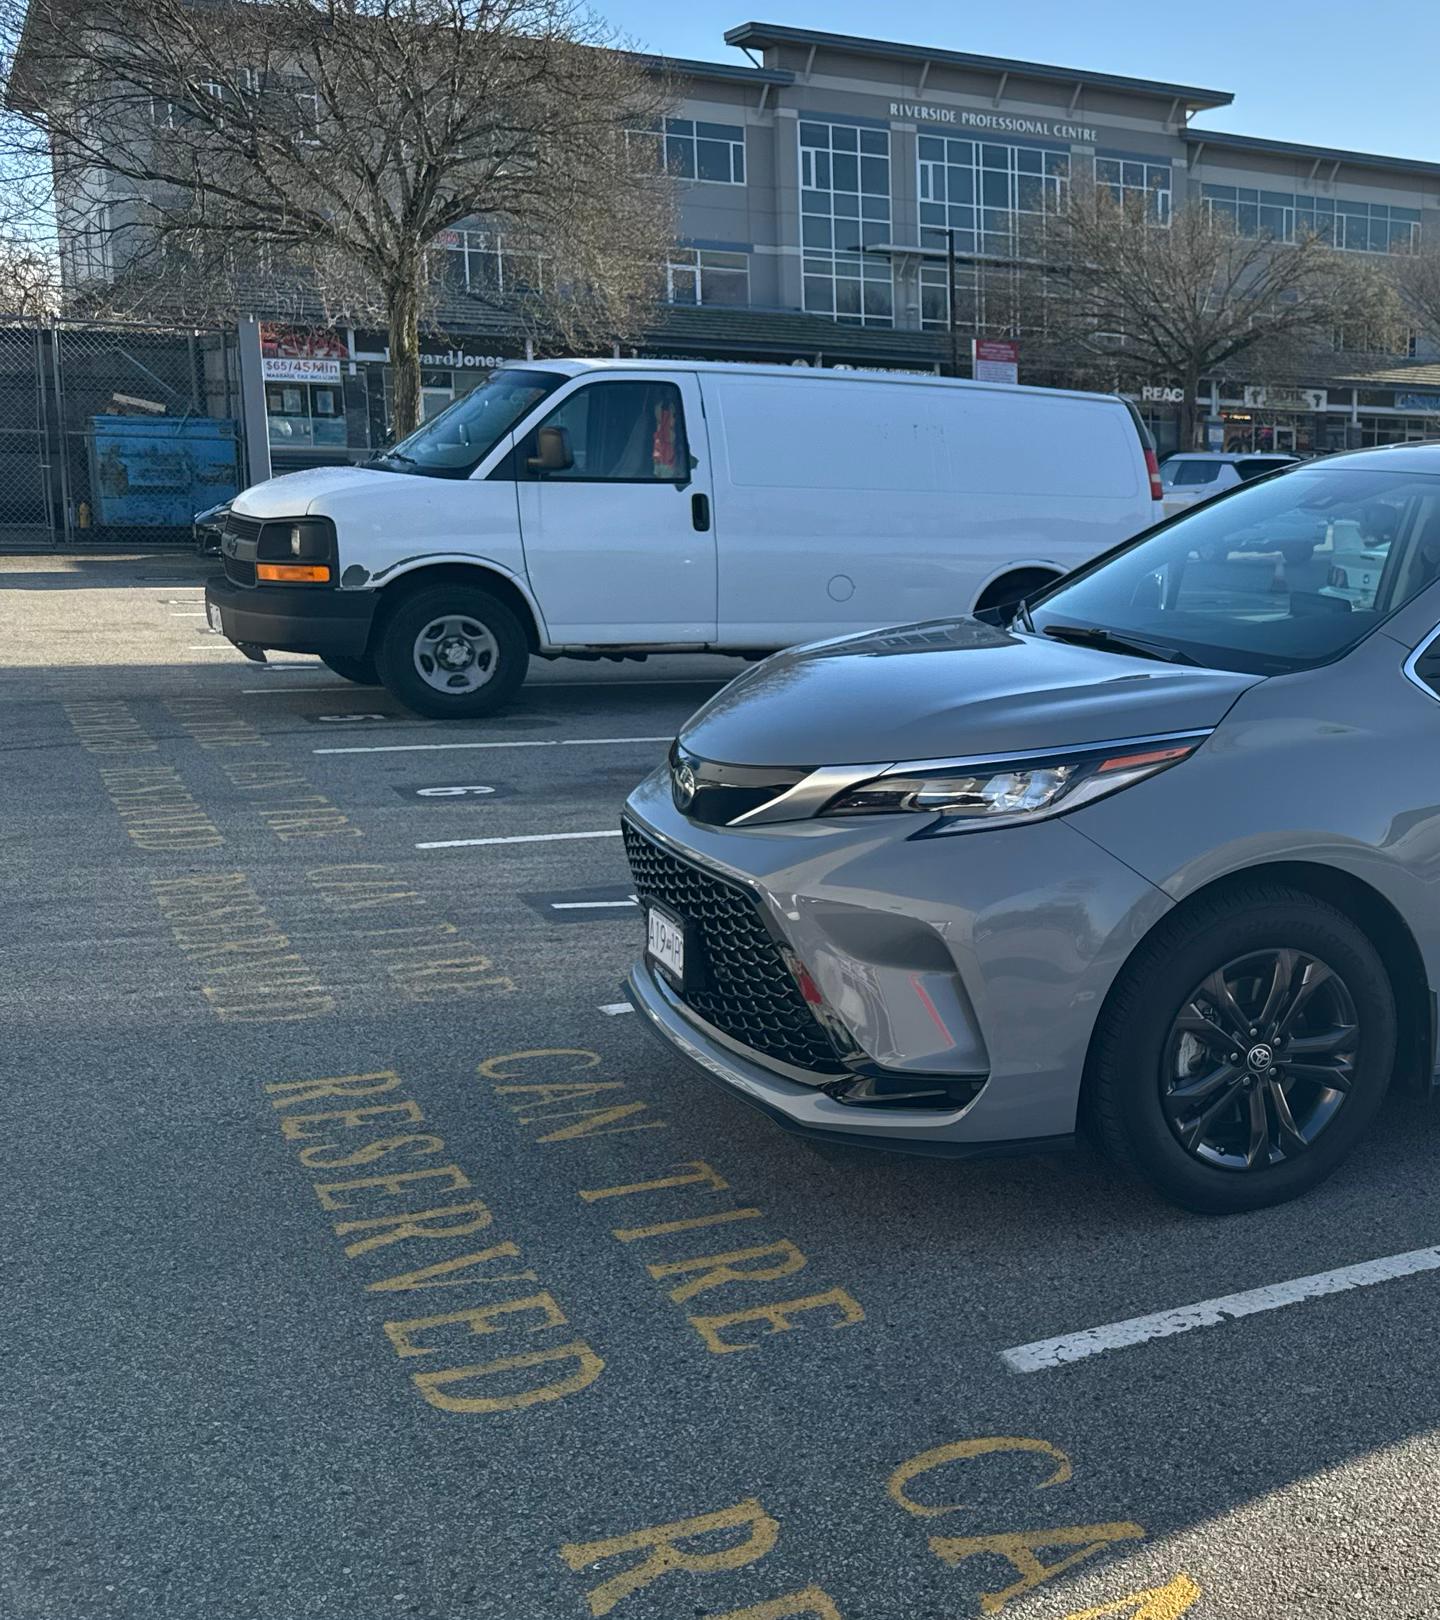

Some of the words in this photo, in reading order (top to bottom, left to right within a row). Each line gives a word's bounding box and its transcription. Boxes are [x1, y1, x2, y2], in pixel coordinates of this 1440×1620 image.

[889, 102, 957, 123] RIVERSIDE
[961, 112, 1050, 135] PROFESSIONAL
[1053, 125, 1098, 142] CENTRE
[455, 350, 504, 368] Jones
[1142, 386, 1184, 402] REAC
[98, 766, 227, 850] RESERVED
[416, 785, 496, 797] 6
[476, 1048, 668, 1144] CAN
[577, 1159, 866, 1356] TIRE
[264, 1069, 606, 1414] RESERVED
